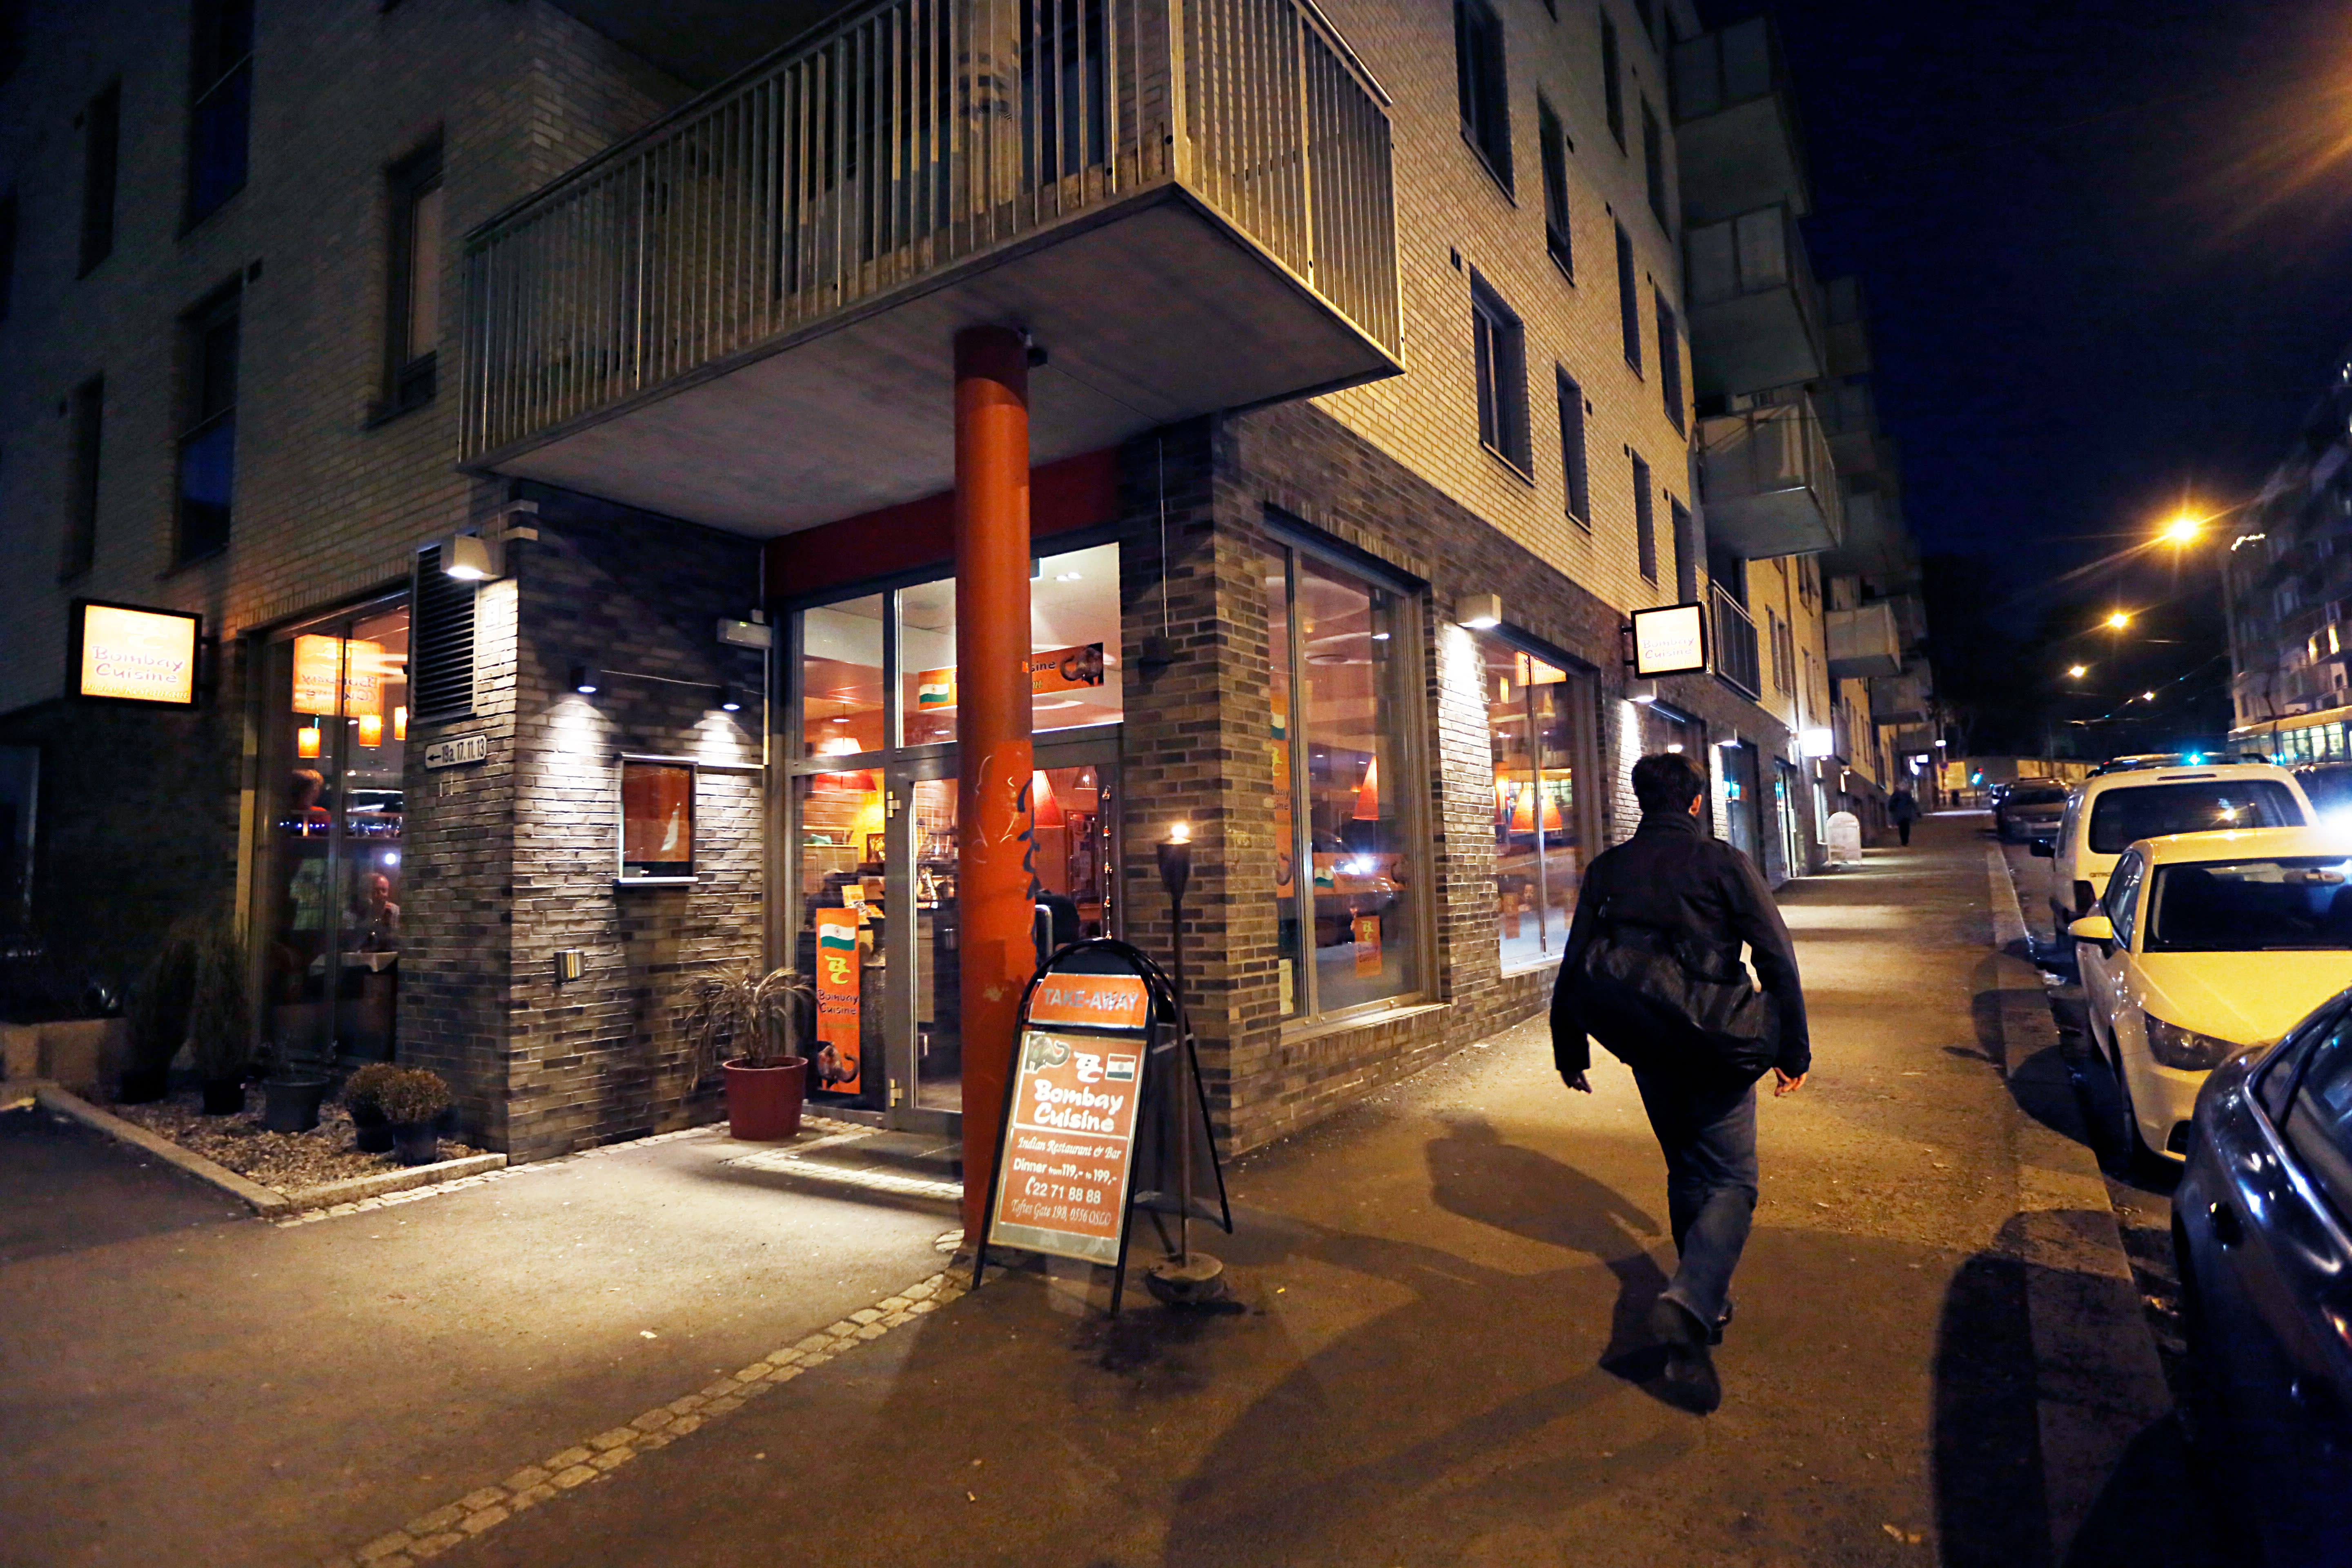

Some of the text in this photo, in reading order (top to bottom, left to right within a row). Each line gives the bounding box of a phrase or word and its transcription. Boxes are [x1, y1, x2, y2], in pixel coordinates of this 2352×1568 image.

[93, 646, 183, 671] Bombay
[1645, 649, 1692, 659] Cuisine
[96, 663, 177, 682] Cuisine
[1031, 660, 1056, 672] sine
[477, 738, 484, 757] 13
[818, 989, 859, 1005] Bombay
[1043, 988, 1139, 1010] TAKE-AWAY
[819, 1002, 857, 1015] Cuisine
[1034, 1079, 1124, 1115] Bombay
[1034, 1102, 1114, 1132] Cuisine
[1018, 1136, 1122, 1159] Indian Restaurant & Bar
[1013, 1157, 1047, 1173] Dinner
[1048, 1166, 1062, 1175] from
[1062, 1163, 1083, 1180] 119,-
[1094, 1169, 1117, 1185] 199,-
[1032, 1182, 1101, 1204] 22 71 88 88
[1033, 1203, 1051, 1220] Gate
[1070, 1208, 1088, 1222] 0556
[1089, 1210, 1111, 1226] OSLO
